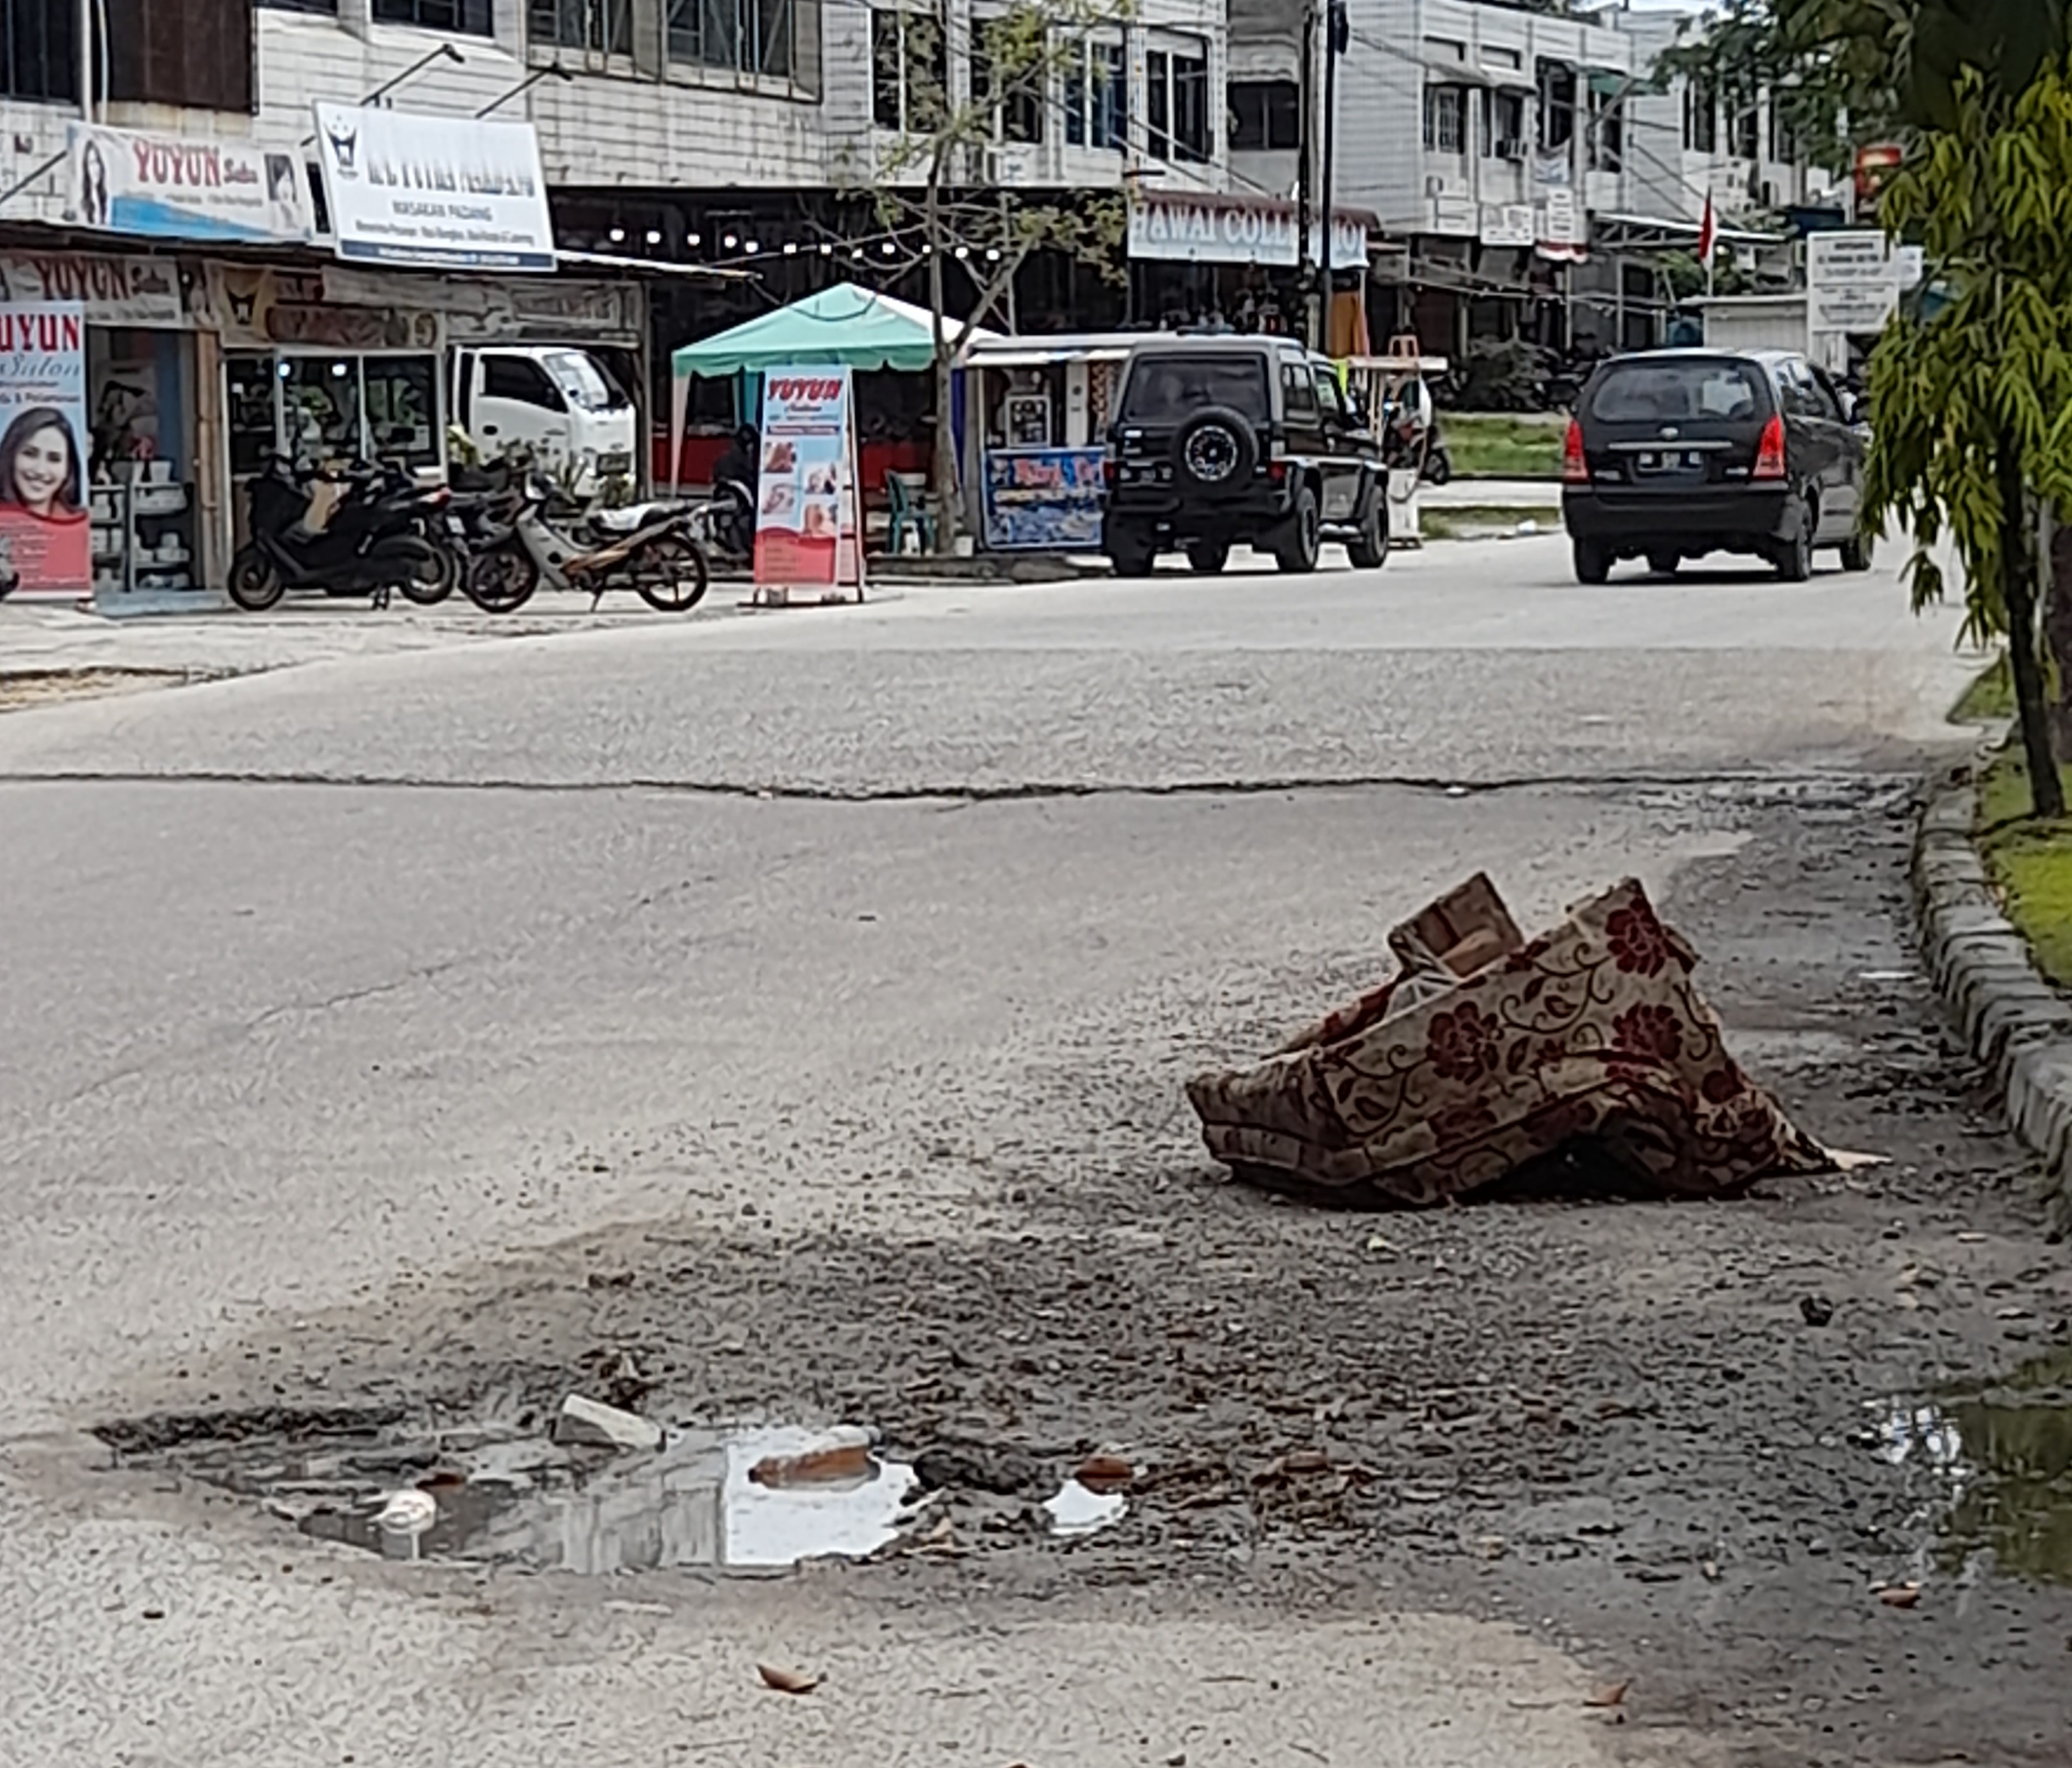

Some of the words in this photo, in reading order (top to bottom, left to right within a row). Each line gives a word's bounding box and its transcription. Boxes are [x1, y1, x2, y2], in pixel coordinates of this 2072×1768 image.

[133, 140, 222, 187] YUYUN
[1131, 202, 1217, 242] HAWAI
[35, 255, 131, 300] YUYUN
[767, 378, 843, 401] YUYUN
